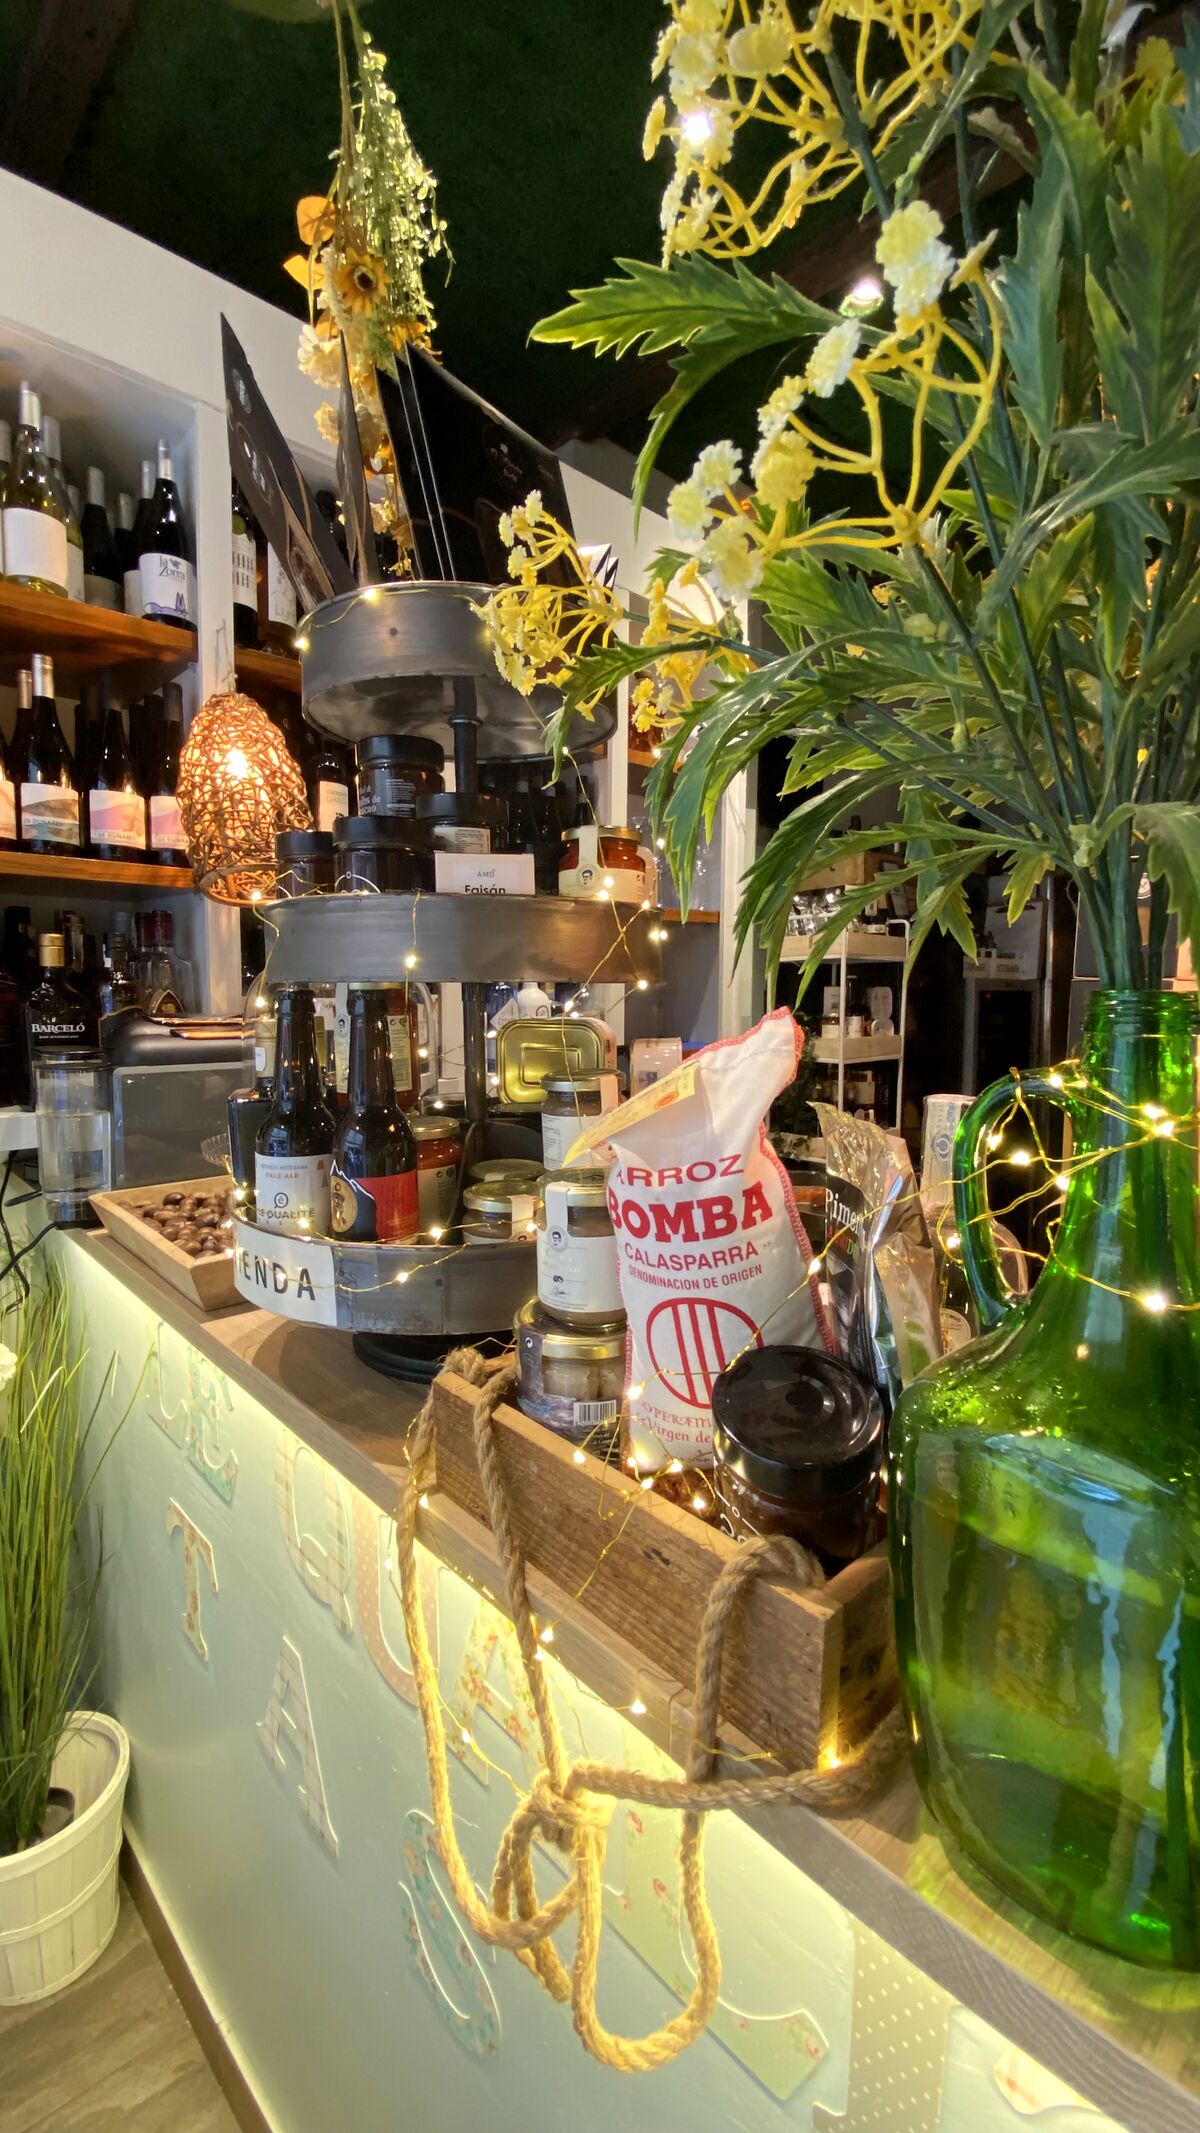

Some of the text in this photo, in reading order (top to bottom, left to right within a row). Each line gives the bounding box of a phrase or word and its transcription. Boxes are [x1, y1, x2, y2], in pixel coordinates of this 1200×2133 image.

[159, 566, 186, 581] Zorra
[464, 884, 506, 895] Faisán
[31, 1021, 85, 1034] BARCELÓ
[607, 1181, 773, 1243] BOMBA
[624, 1240, 759, 1272] CALASPARRA
[240, 1248, 316, 1301] ENDA
[628, 1264, 763, 1291] DENOMINACION DE ORIGEN
[640, 1400, 713, 1428] OPERATIV
[695, 1430, 712, 1443] de
